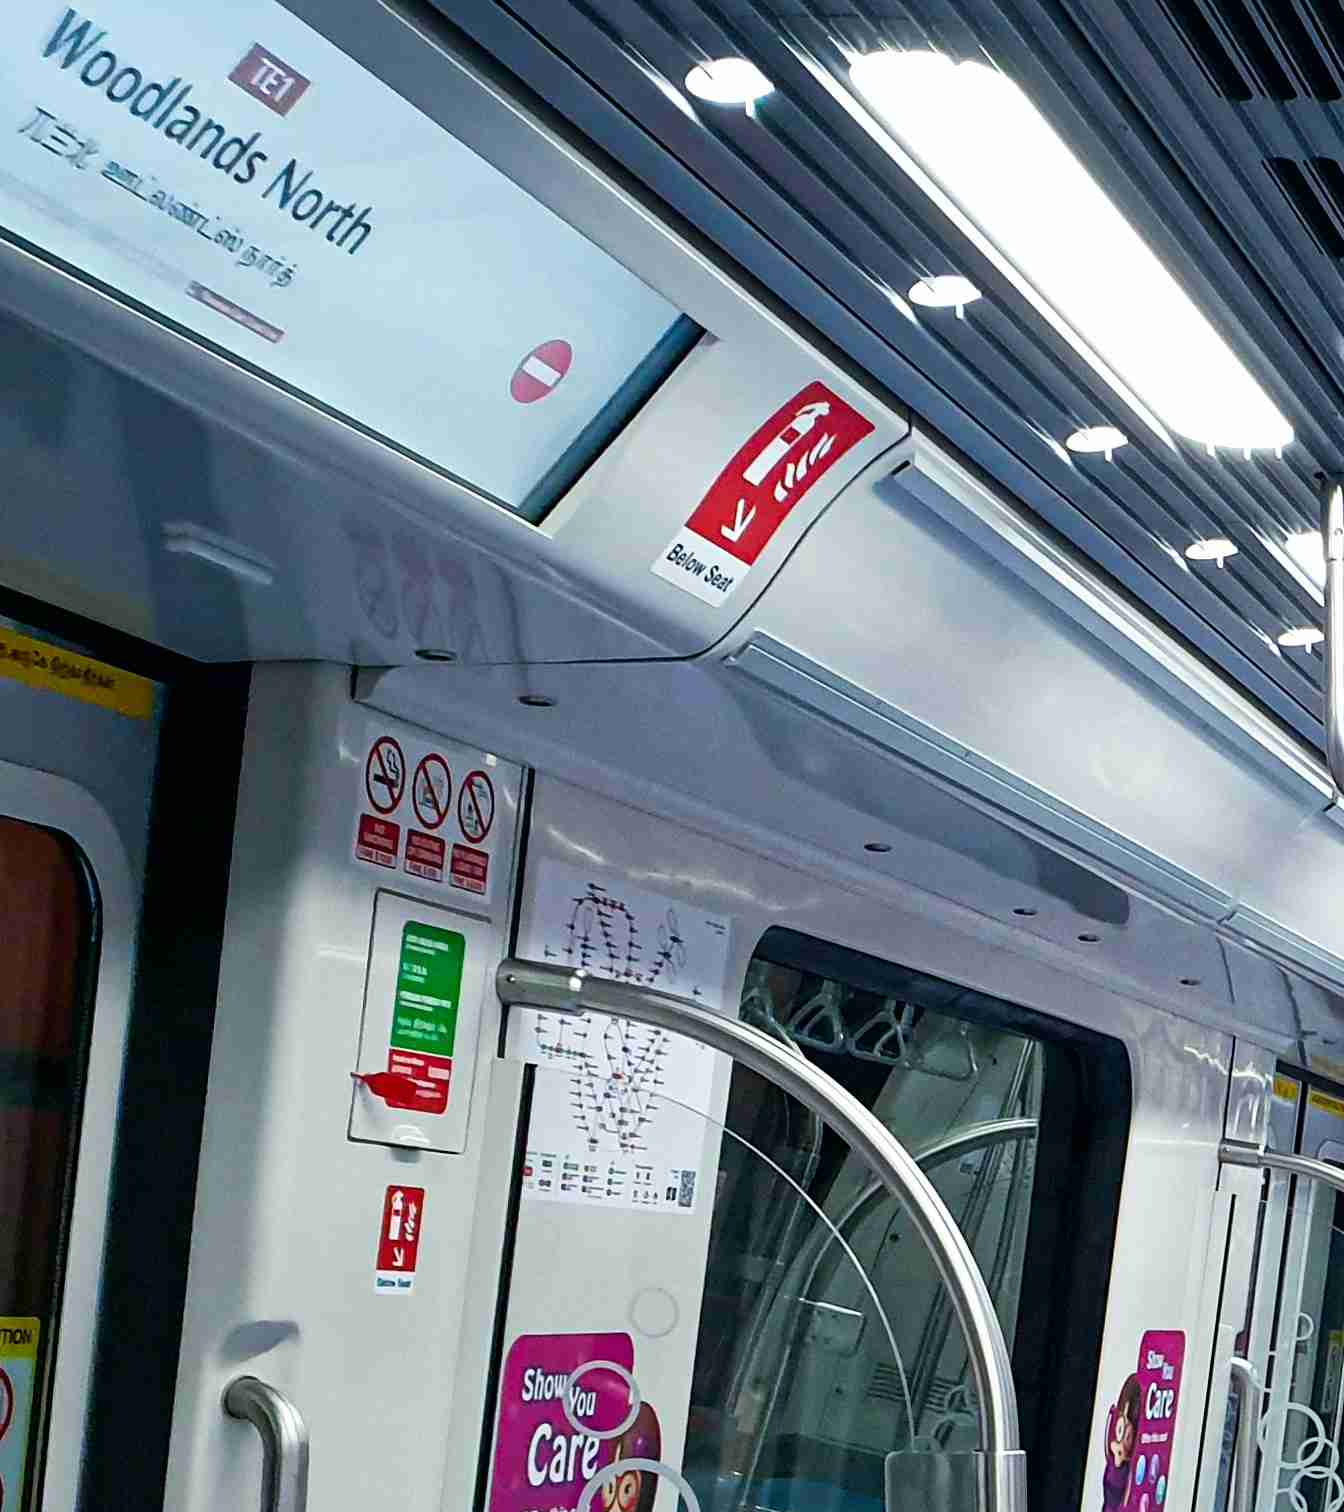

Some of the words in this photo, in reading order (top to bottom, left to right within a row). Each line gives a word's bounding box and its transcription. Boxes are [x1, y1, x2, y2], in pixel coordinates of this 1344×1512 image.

[247, 57, 295, 102] TE1
[41, 8, 267, 185] Woodlands
[261, 159, 373, 255] North
[666, 543, 707, 576] Below
[704, 564, 734, 592] Seat
[521, 1367, 568, 1401] Show
[568, 1386, 597, 1417] You
[1145, 1382, 1174, 1420] Care
[527, 1422, 600, 1487] Care
